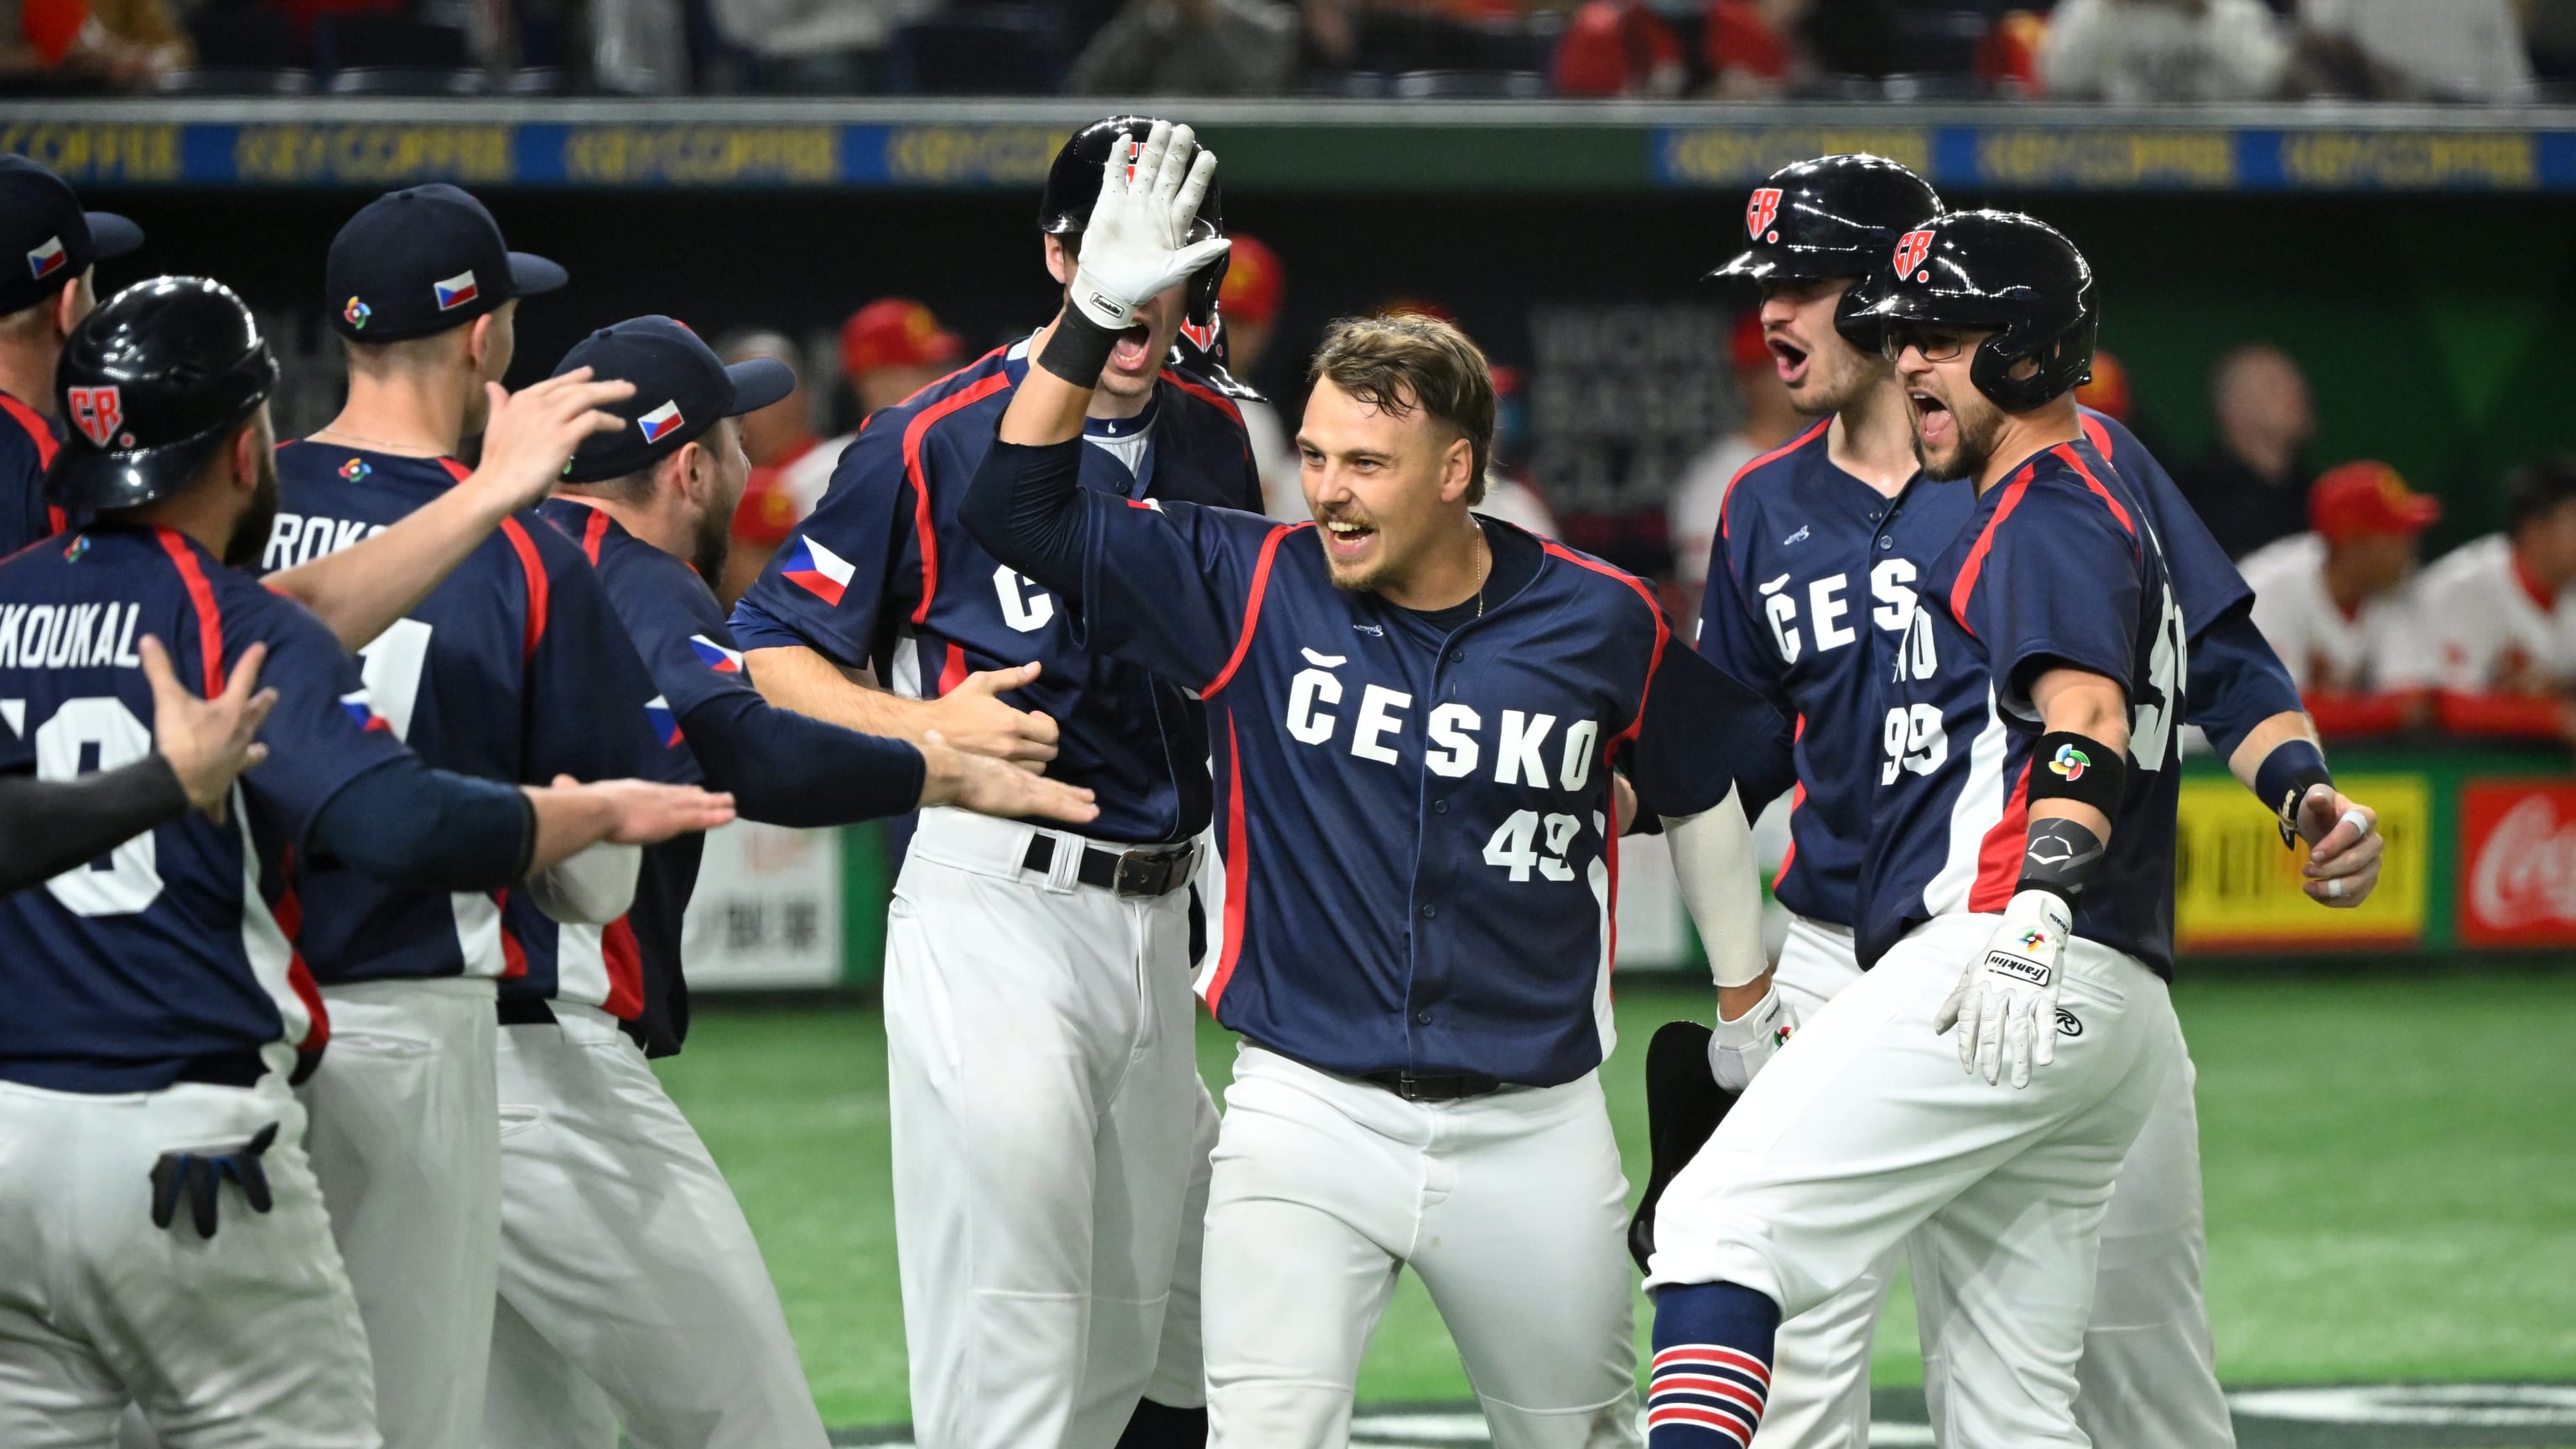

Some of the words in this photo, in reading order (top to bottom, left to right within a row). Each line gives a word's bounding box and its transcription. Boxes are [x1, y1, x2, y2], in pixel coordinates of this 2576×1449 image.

[261, 512, 388, 572] ROK
[0, 601, 141, 669] KOUKAL
[1286, 647, 1597, 792] ČESKO
[1881, 703, 1949, 787] 99
[1482, 808, 1582, 882] 49
